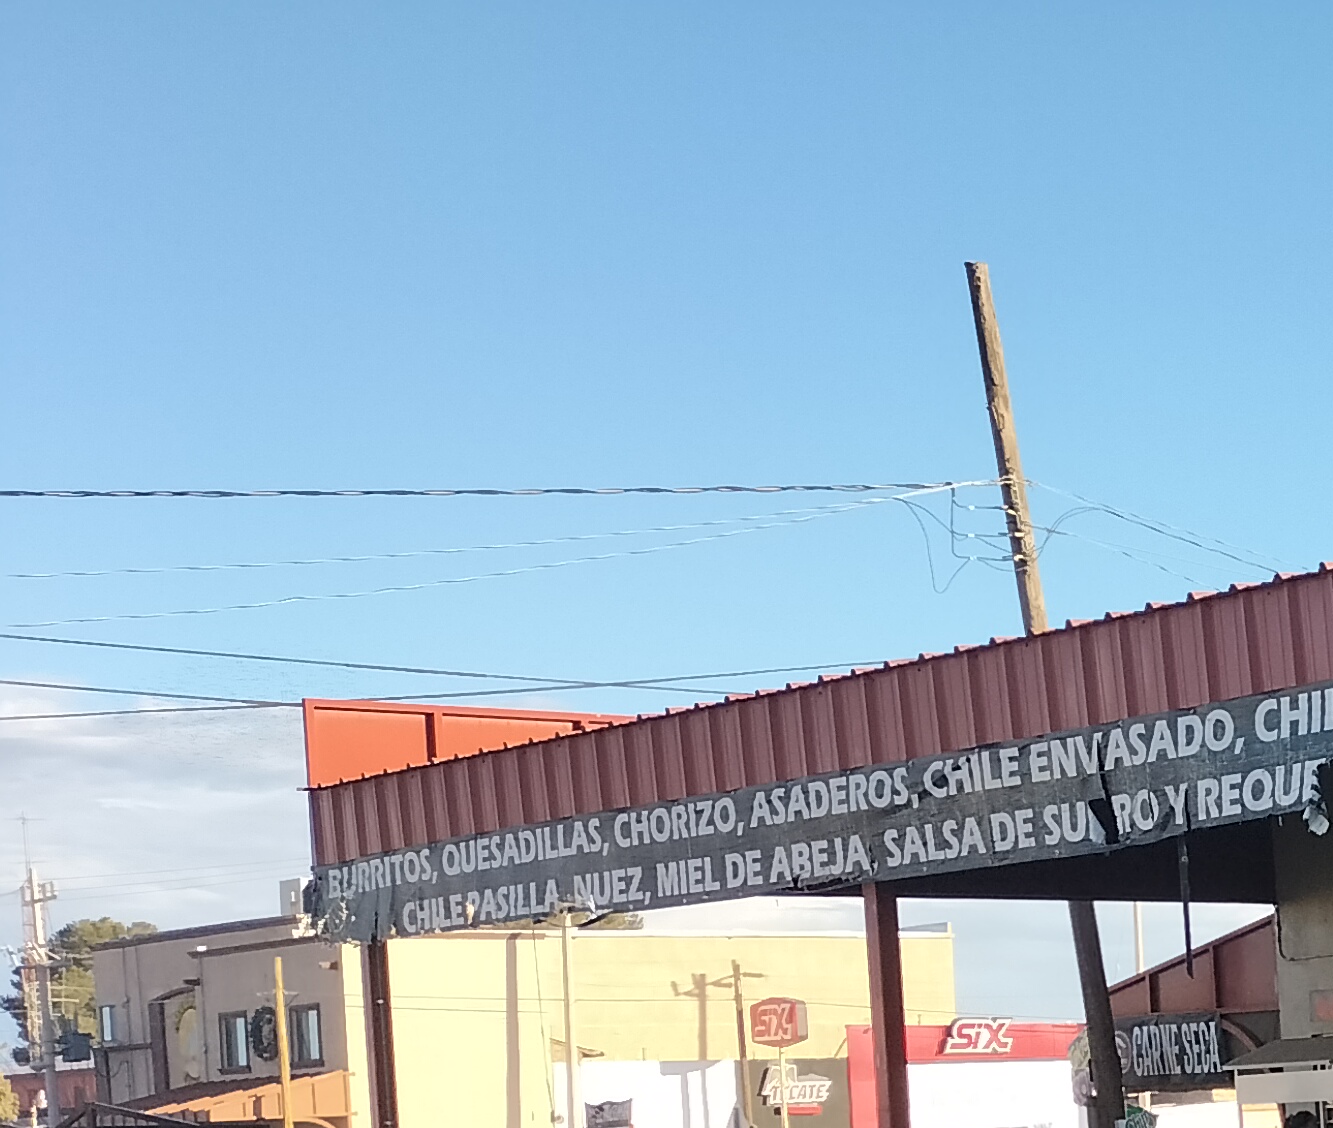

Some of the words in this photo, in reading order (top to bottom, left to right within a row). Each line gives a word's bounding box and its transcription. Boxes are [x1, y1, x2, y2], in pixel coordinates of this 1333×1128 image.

[327, 848, 438, 899] BURRITOS,
[442, 818, 609, 876] QUESADILLAS,
[614, 797, 744, 847] CHORIZO,
[750, 766, 920, 829] ASADEROS,
[923, 747, 1021, 798] CHILE
[1029, 709, 1244, 783] ENVASADO,
[402, 893, 465, 934] CHILE
[573, 866, 651, 906] NUEZ,
[656, 857, 720, 897] MIEL
[725, 849, 763, 888] DE
[883, 817, 986, 868] SALSA
[990, 809, 1036, 853] DE
[1043, 788, 1159, 846] SURO
[1164, 782, 1188, 825] Y
[770, 1083, 828, 1102] TCATE
[1132, 1023, 1182, 1076] CARNE
[1181, 1021, 1222, 1073] SECA
